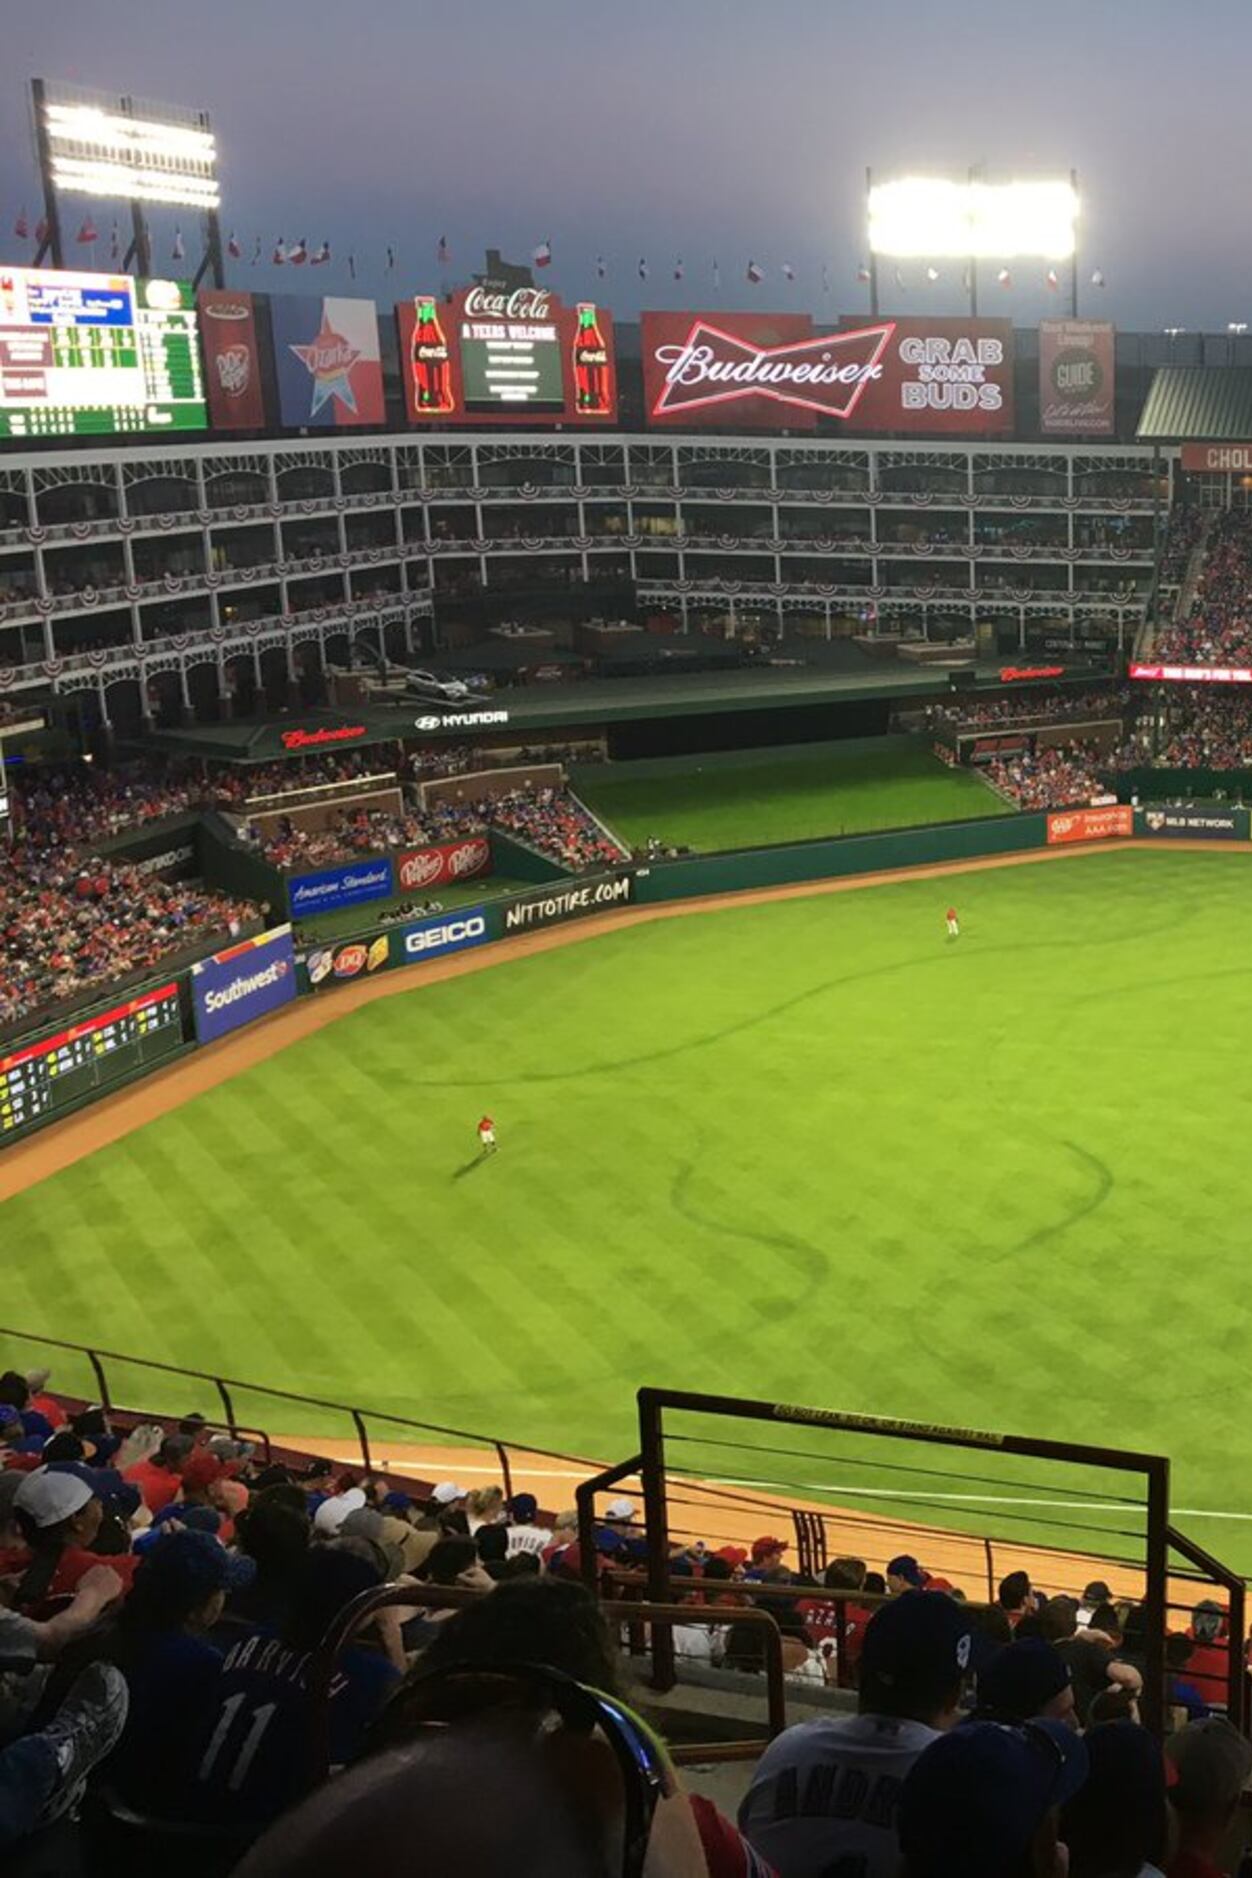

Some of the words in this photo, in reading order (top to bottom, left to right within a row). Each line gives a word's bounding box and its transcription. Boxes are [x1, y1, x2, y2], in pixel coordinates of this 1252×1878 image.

[472, 323, 506, 339] TEXAS
[508, 324, 556, 340] WELCOME
[655, 344, 883, 386] Budweiser
[899, 337, 1004, 365] GRAB
[918, 365, 987, 383] SOME
[1057, 361, 1095, 389] GUIDE
[900, 382, 1004, 410] BUDS
[442, 711, 509, 728] HYUNDAI
[281, 726, 366, 750] Budweiser
[1166, 817, 1186, 827] MLB
[1187, 818, 1235, 829] NETWORK
[340, 867, 388, 891] Standard
[506, 878, 630, 929] NITTOTIRE.COM
[405, 916, 486, 954] GEICO
[204, 963, 278, 1014] Southwest
[198, 1692, 279, 1793] 11
